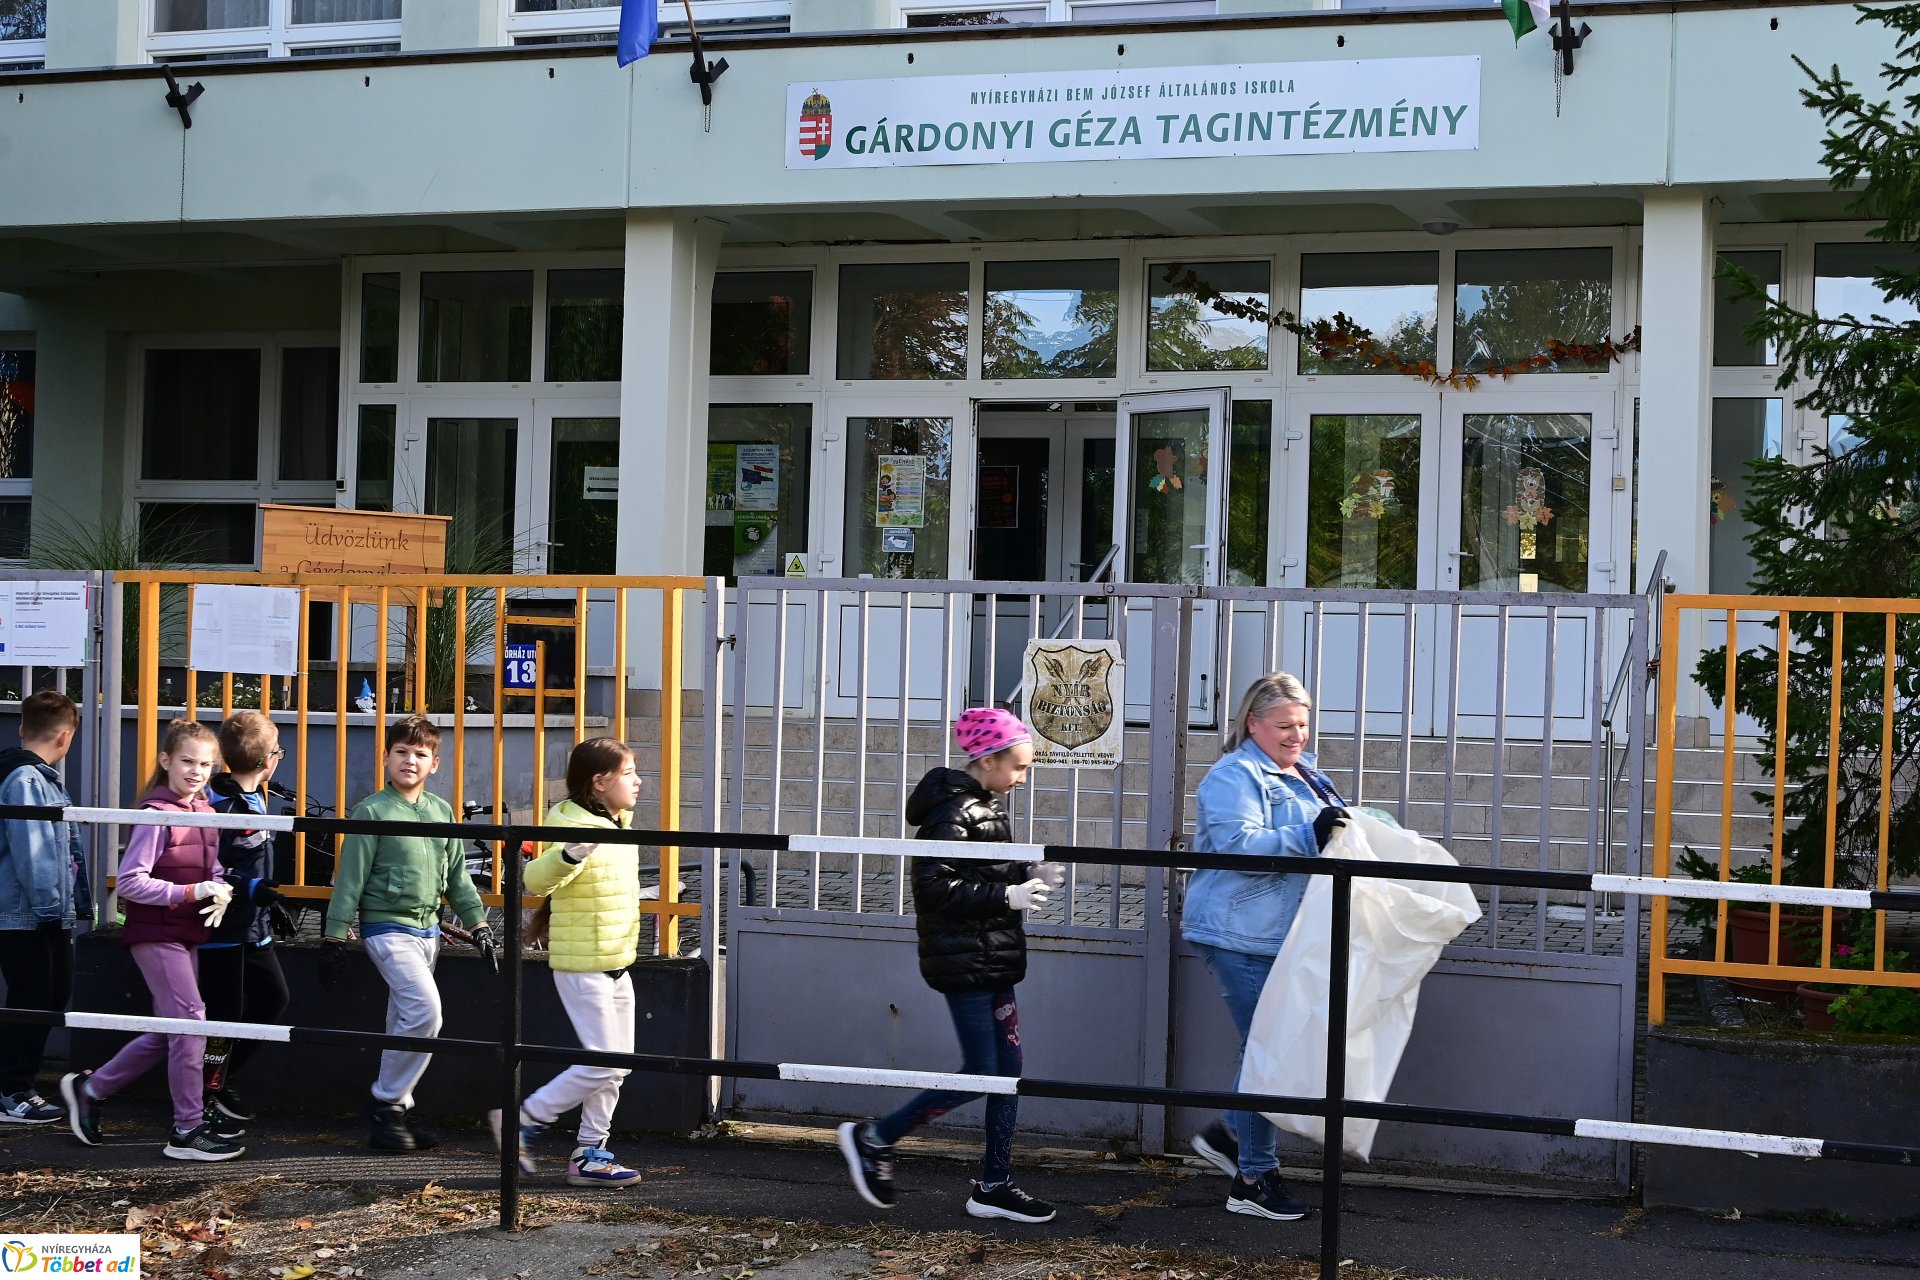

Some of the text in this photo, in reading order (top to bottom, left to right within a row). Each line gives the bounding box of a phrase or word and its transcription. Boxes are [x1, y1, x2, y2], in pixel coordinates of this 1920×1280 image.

[970, 79, 1295, 105] NYÍREGYHÁZI BEM JÓZSEF ÁLTALÁNOS ISKOLA
[845, 98, 1468, 155] GÁRDONYI GÉZA TAGINTÉZMÉNY
[304, 522, 410, 551] Üdvözlünk
[504, 646, 526, 659] ÓRHÁZ
[506, 660, 537, 684] 13
[1050, 681, 1091, 698] NYÍR
[1037, 700, 1107, 717] BIZTONSÁG
